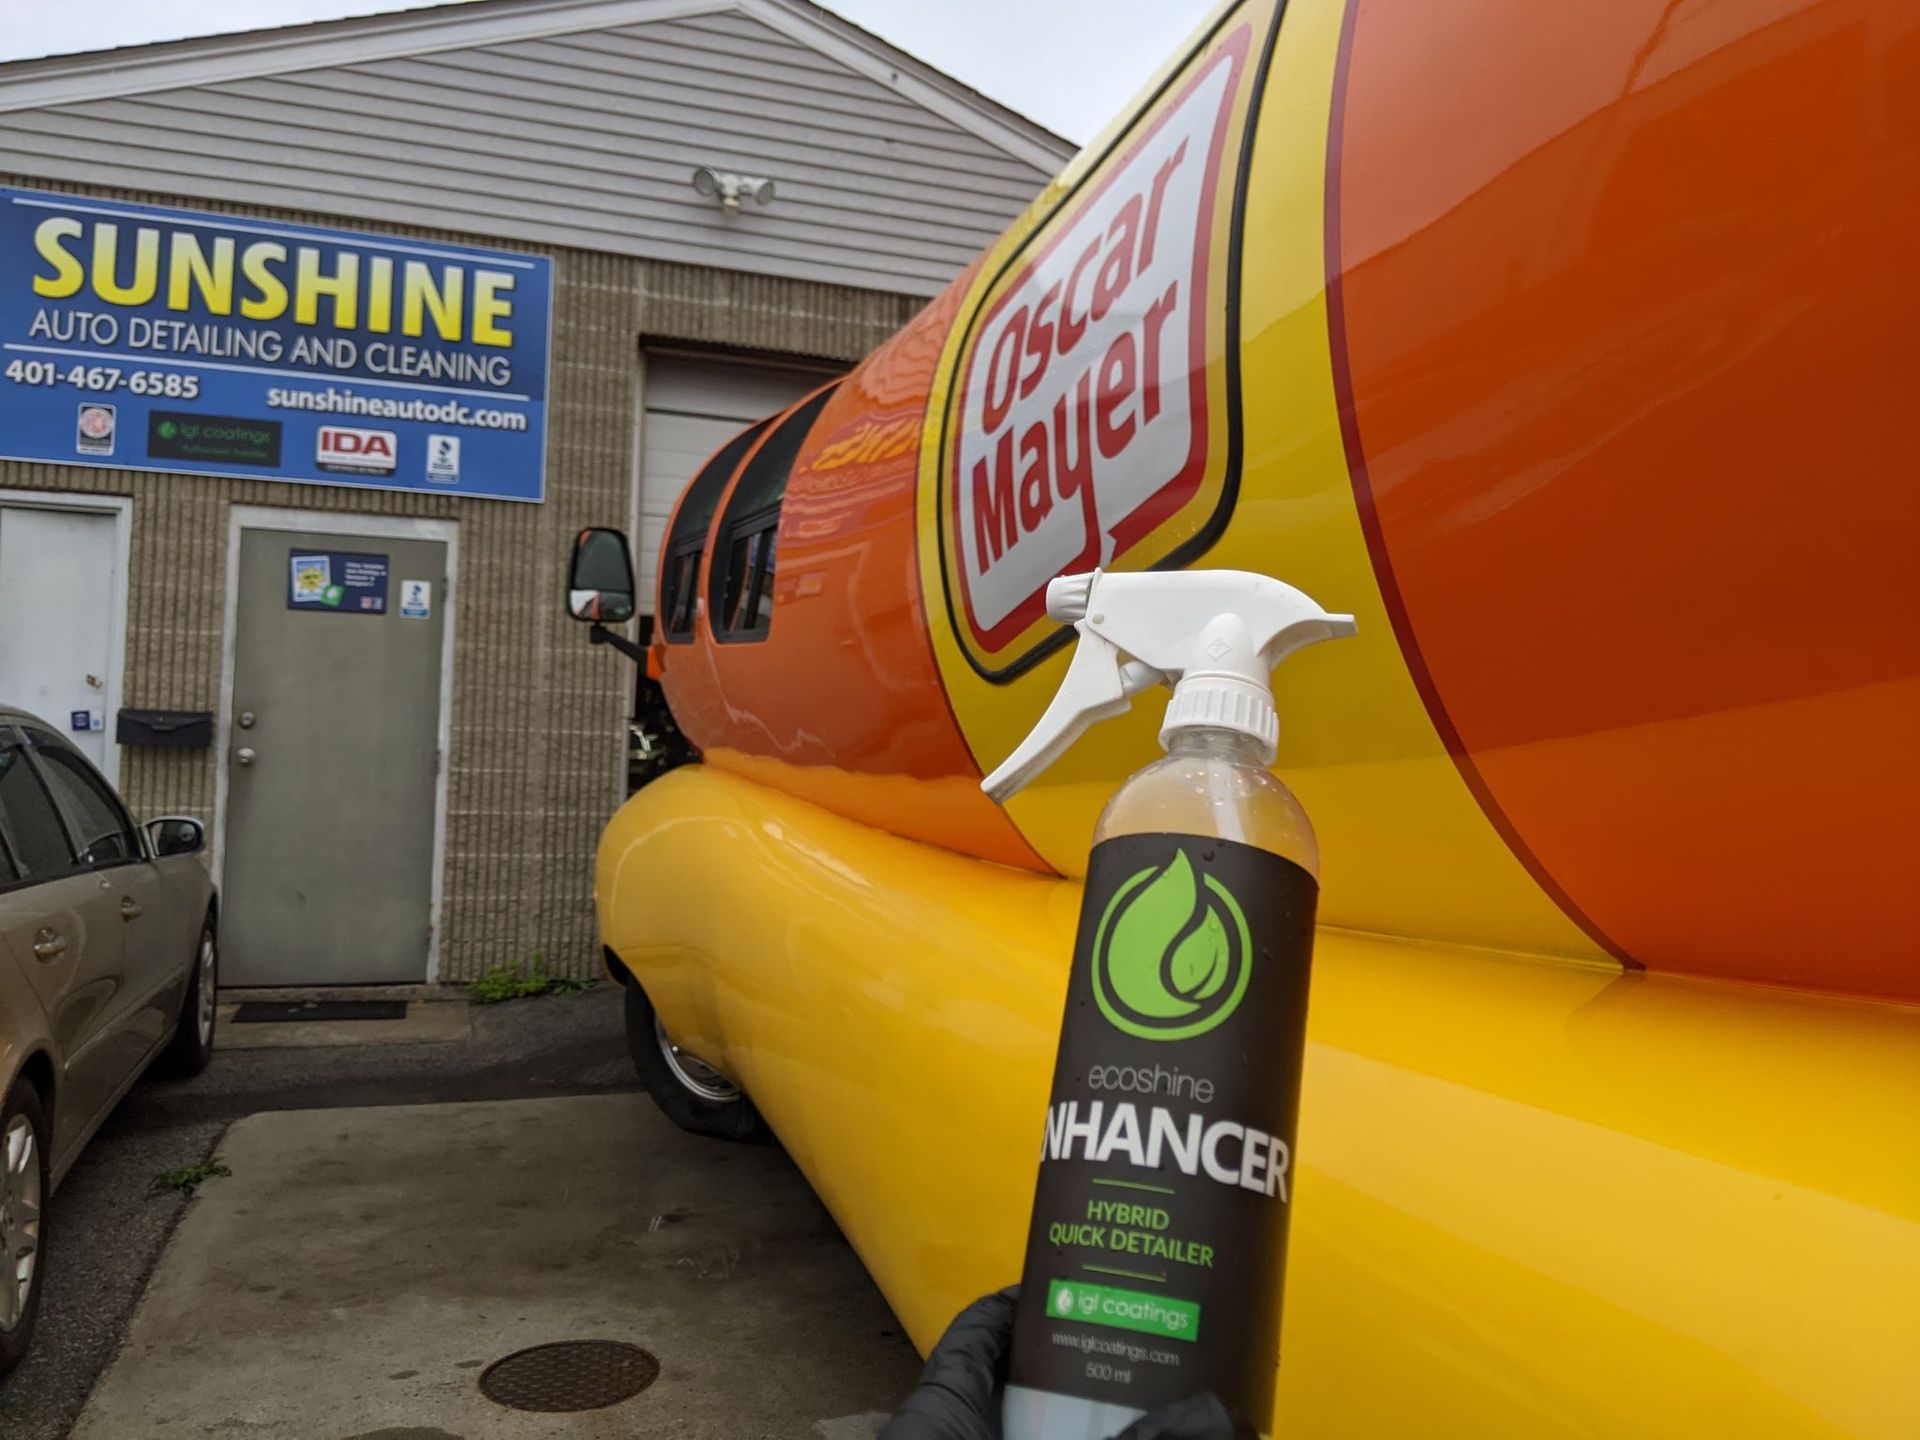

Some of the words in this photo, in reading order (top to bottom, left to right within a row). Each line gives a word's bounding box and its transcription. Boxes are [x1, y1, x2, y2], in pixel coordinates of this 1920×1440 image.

[32, 216, 516, 348] SUNSHINE
[981, 135, 1190, 435] Oscar
[29, 308, 119, 345] AUTO
[128, 319, 283, 362] DETAILING
[289, 334, 357, 369] AND
[364, 343, 512, 387] CLEANING
[5, 360, 200, 398] 401-467-6585
[266, 386, 527, 430] sunshineautodc.com
[322, 431, 391, 456] IDA
[972, 280, 1178, 578] Mayer
[1089, 1064, 1214, 1102] ecoshine
[1087, 1200, 1169, 1230] HYBRID
[1050, 1223, 1103, 1247] QUICK
[1110, 1231, 1213, 1267] DETAILER
[1102, 1297, 1188, 1330] coatings
[1086, 1361, 1112, 1380] 500
